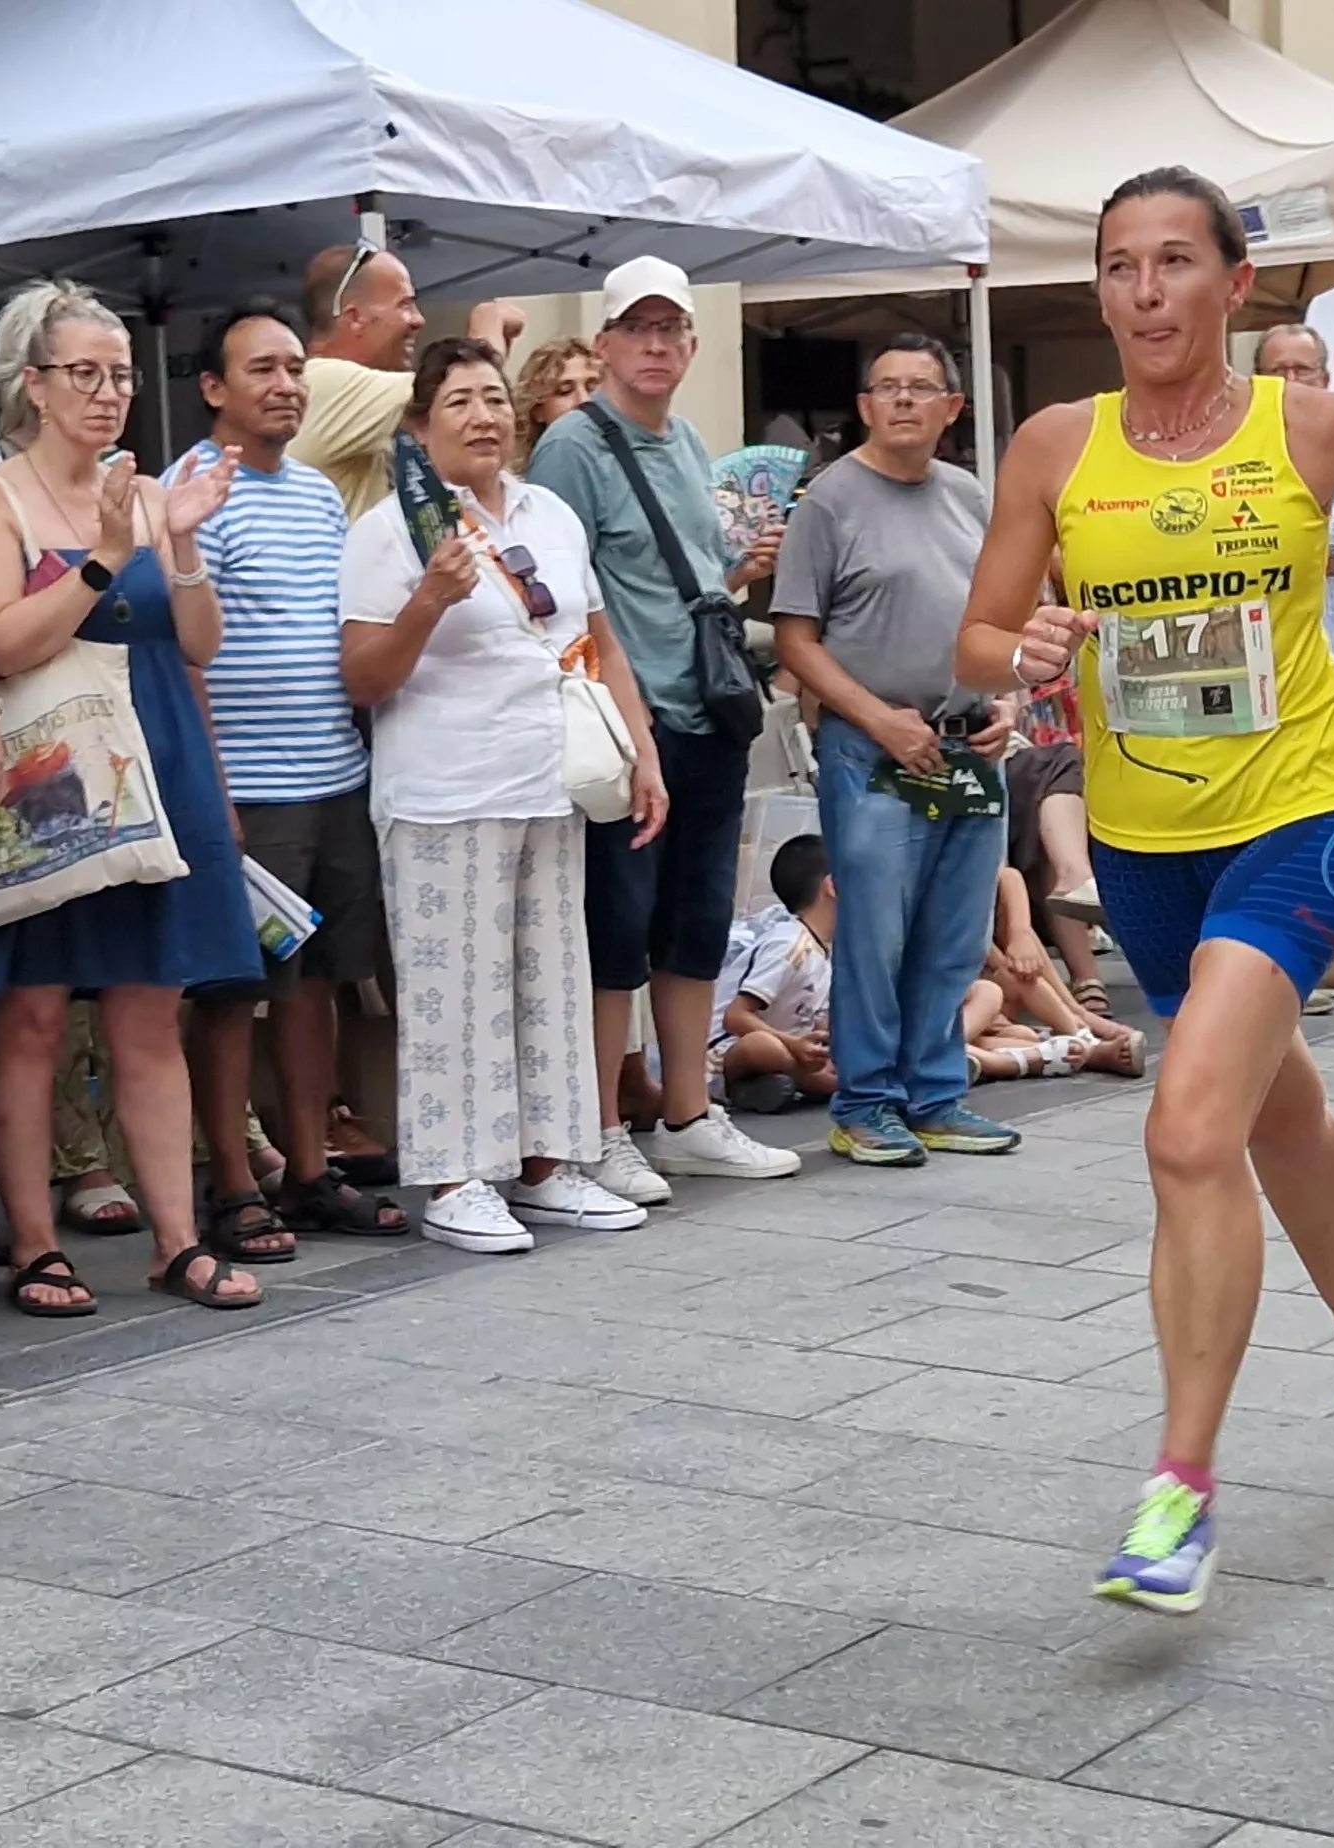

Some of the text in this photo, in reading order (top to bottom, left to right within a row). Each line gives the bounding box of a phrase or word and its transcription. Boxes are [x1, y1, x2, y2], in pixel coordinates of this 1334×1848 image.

[1085, 498, 1150, 513] Alcampo
[1092, 565, 1292, 608] SCORPIO-71
[1142, 613, 1209, 659] 17
[1148, 685, 1179, 698] GRAN
[1128, 695, 1188, 711] CARRERA
